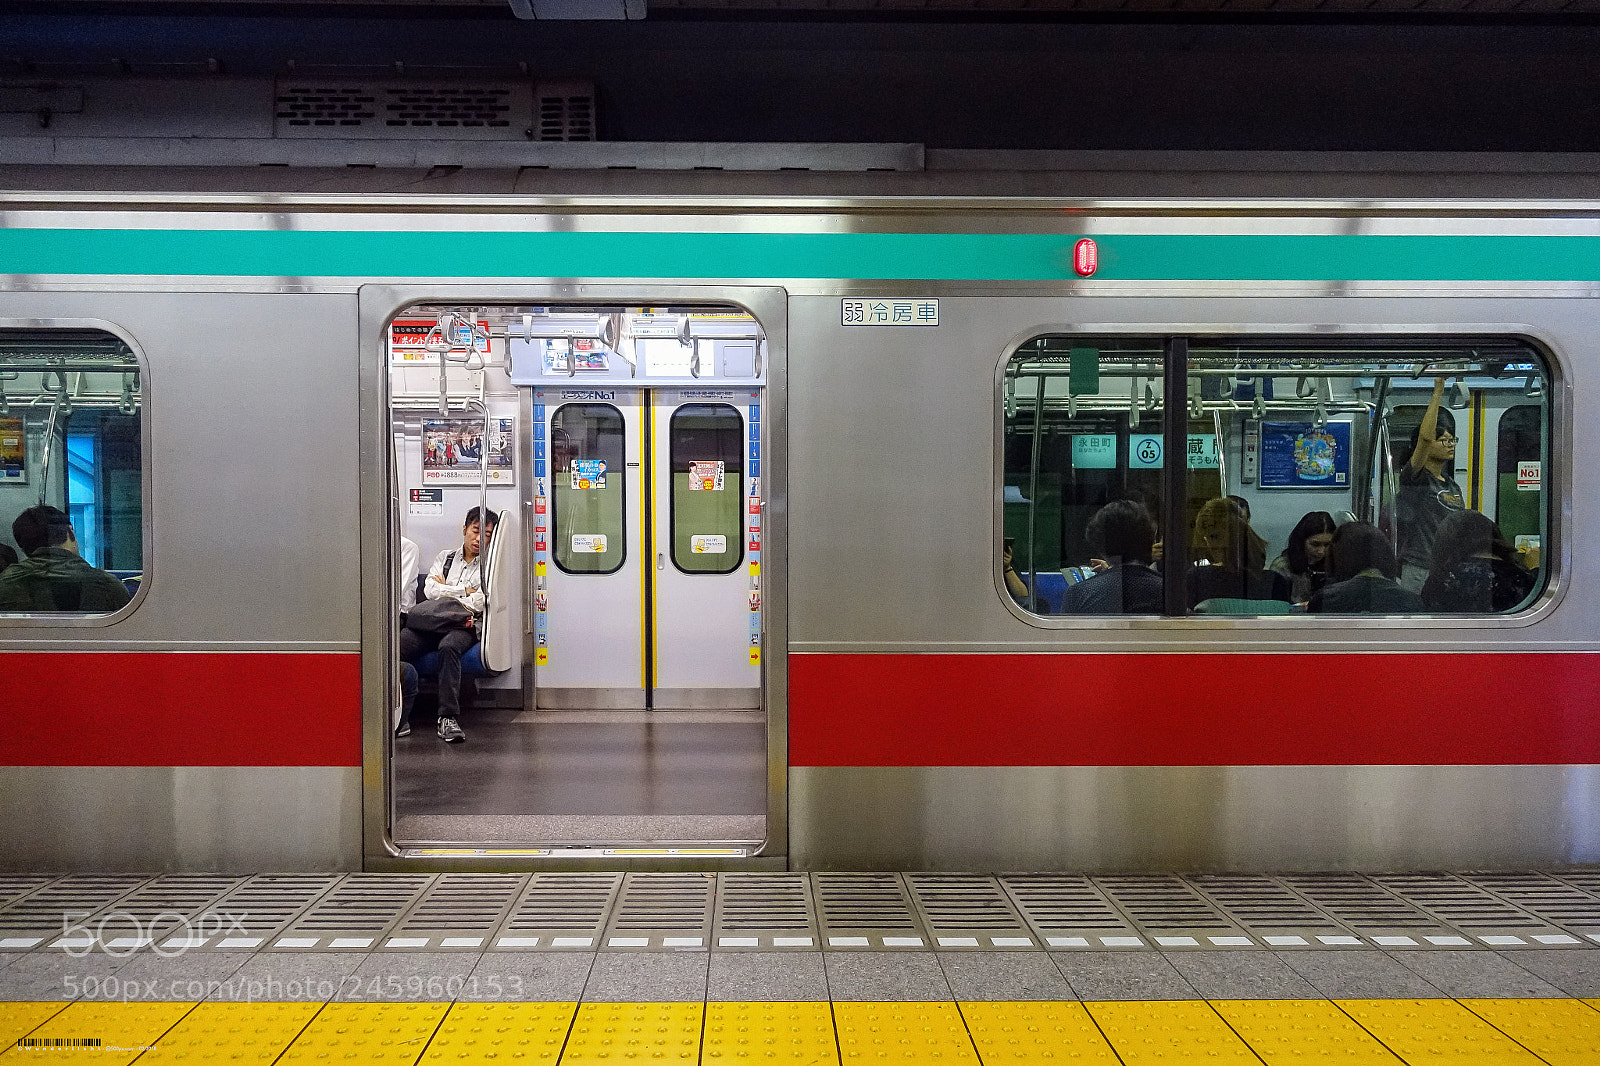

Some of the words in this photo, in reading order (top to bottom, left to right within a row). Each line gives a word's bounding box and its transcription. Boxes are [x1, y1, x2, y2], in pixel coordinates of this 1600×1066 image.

[844, 302, 937, 322] 弱冷房車
[1078, 437, 1111, 448] 永田町
[1145, 441, 1152, 449] Z
[1141, 451, 1156, 459] 05
[1520, 469, 1539, 478] No.1
